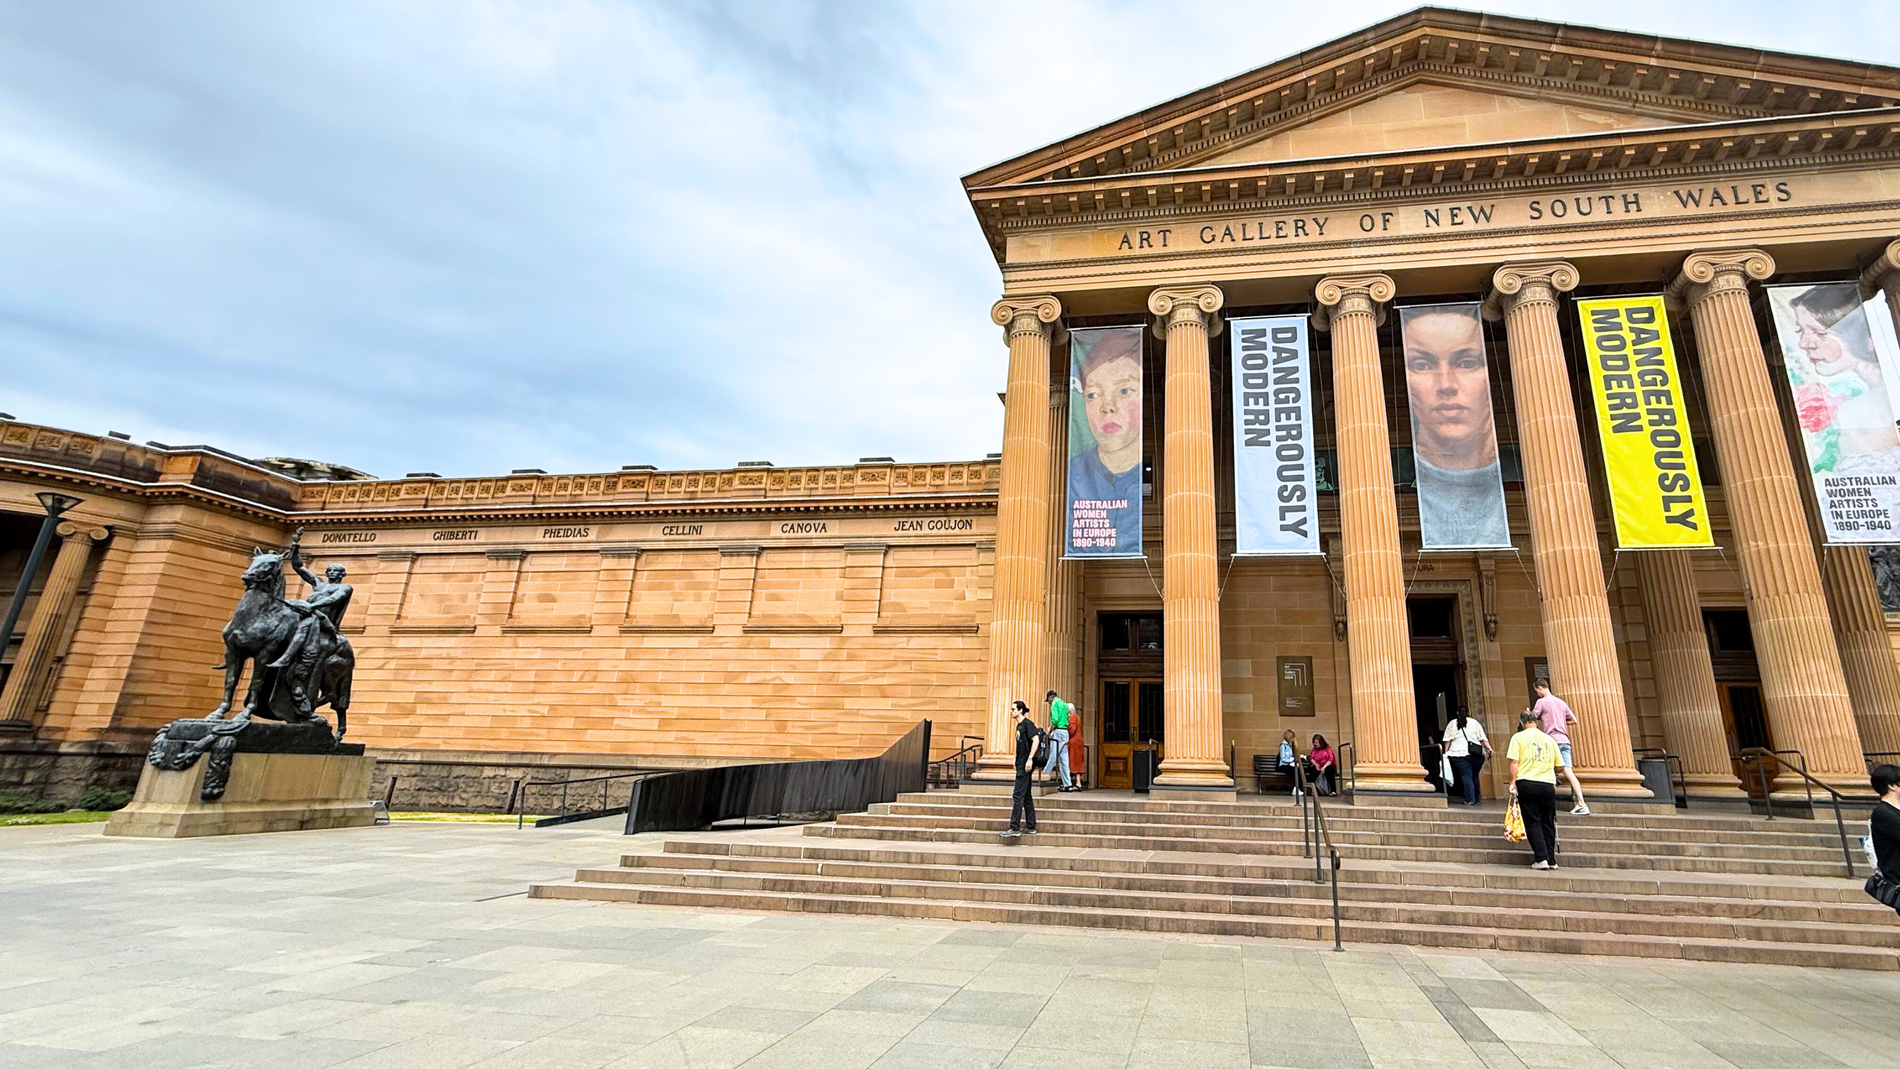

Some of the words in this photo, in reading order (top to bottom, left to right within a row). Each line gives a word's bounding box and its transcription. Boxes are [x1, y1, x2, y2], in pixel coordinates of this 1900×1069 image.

[1118, 229, 1172, 250] ART
[1200, 217, 1329, 244] GALLERY
[1359, 212, 1393, 232] OF
[1424, 205, 1495, 227] NEW
[1529, 193, 1642, 220] SOUTH
[1674, 182, 1792, 208] WALES
[1590, 308, 1644, 434] MODERN
[1241, 328, 1271, 447] MODERN
[1624, 306, 1698, 531] DANGEROUSLY
[1271, 326, 1308, 538] DANGEROUSLY
[1824, 476, 1897, 487] AUSTRALIAN
[1825, 487, 1872, 498] WOMEN
[1073, 499, 1128, 509] AUSTRALIAN
[1829, 498, 1878, 509] ARTISTS
[1073, 509, 1107, 518] WOMEN
[1830, 510, 1843, 520] IN
[1845, 509, 1890, 520] EUROPE
[780, 522, 827, 534] CANOVA
[894, 520, 923, 531] JEAN
[927, 519, 973, 531] GOUJON
[1073, 519, 1110, 528] ARTISTS
[433, 530, 478, 540] GHIBERTI
[543, 528, 589, 538] PHEIDIAS
[662, 525, 703, 535] CELLINI
[1072, 528, 1084, 537] IN
[1083, 528, 1116, 537] EUROPE
[321, 533, 376, 543] DONATELLO
